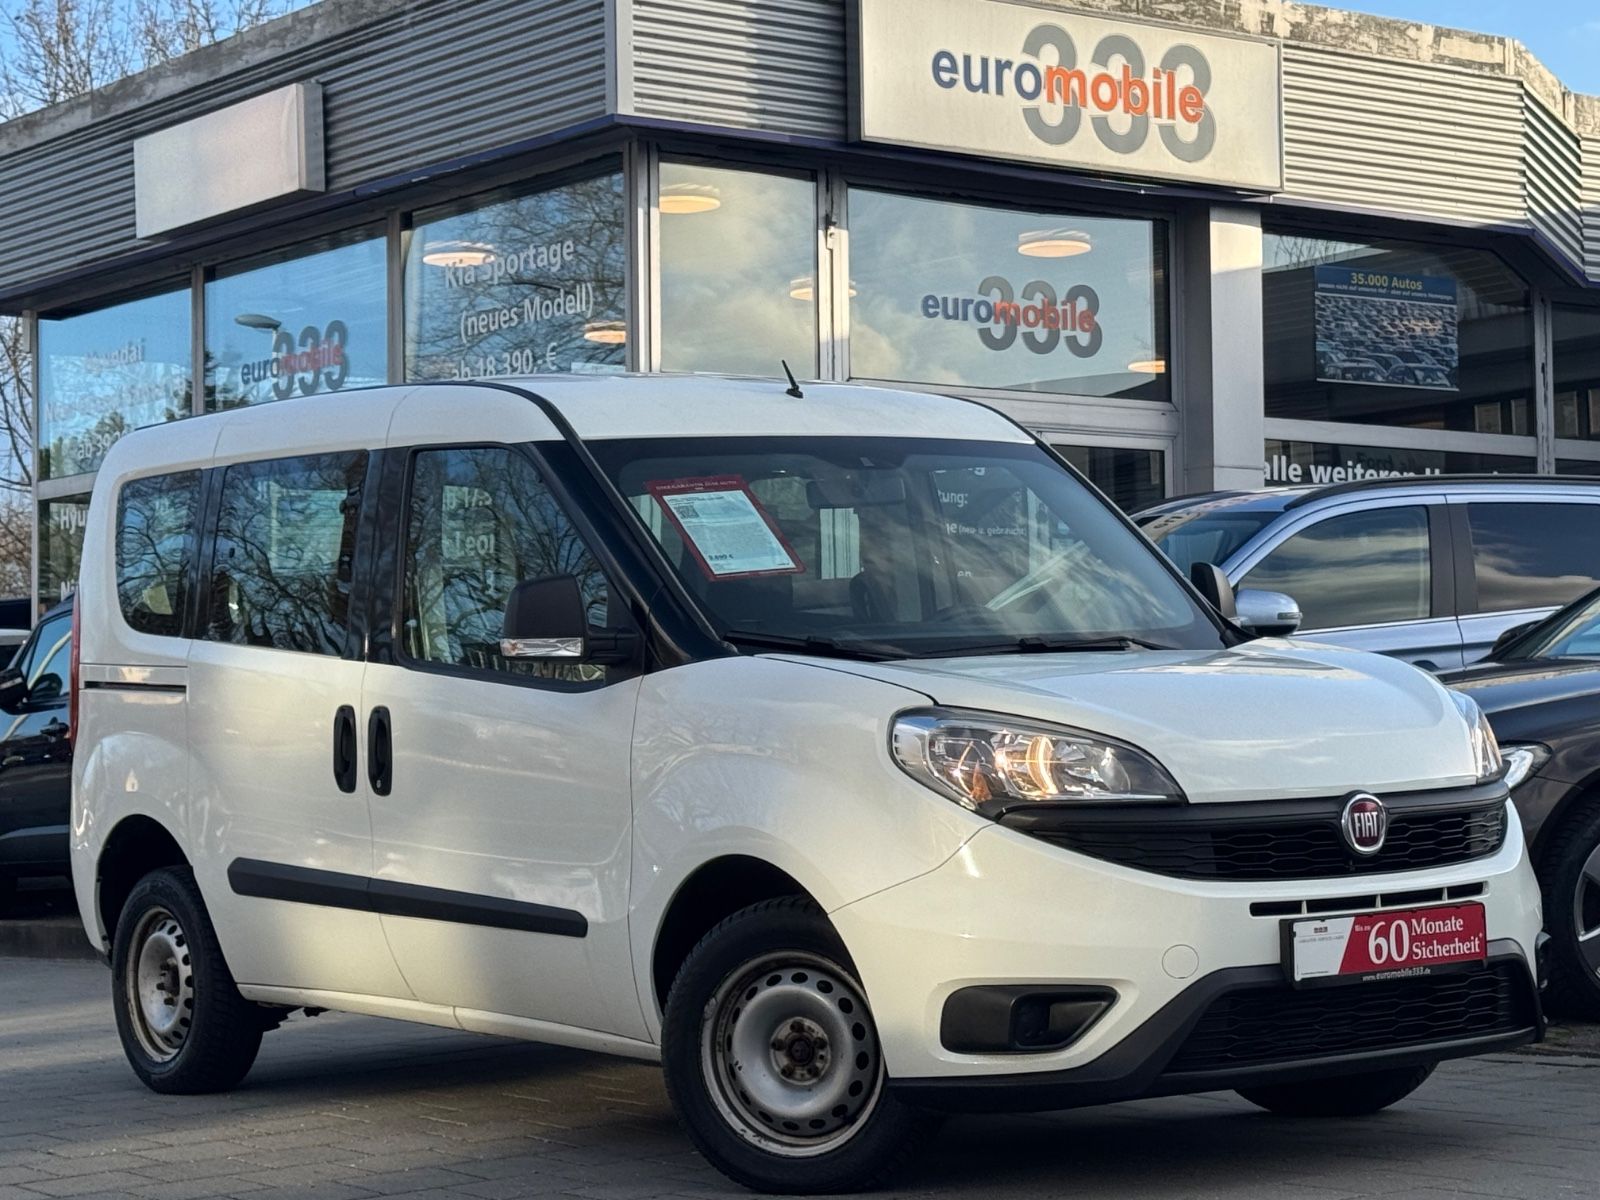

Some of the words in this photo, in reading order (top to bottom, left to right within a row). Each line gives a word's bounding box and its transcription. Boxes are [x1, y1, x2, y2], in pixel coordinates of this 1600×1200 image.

[445, 257, 476, 290] Kia
[478, 239, 576, 285] Sportage
[1350, 272, 1389, 287] 35.000
[1391, 276, 1423, 291] Autos
[460, 306, 519, 346] (neues
[523, 282, 594, 324] Modell)
[451, 359, 471, 381] ab
[1264, 455, 1302, 482] alle
[1353, 811, 1379, 838] FIAT
[1411, 915, 1464, 936] Monate
[1368, 920, 1410, 965] 60
